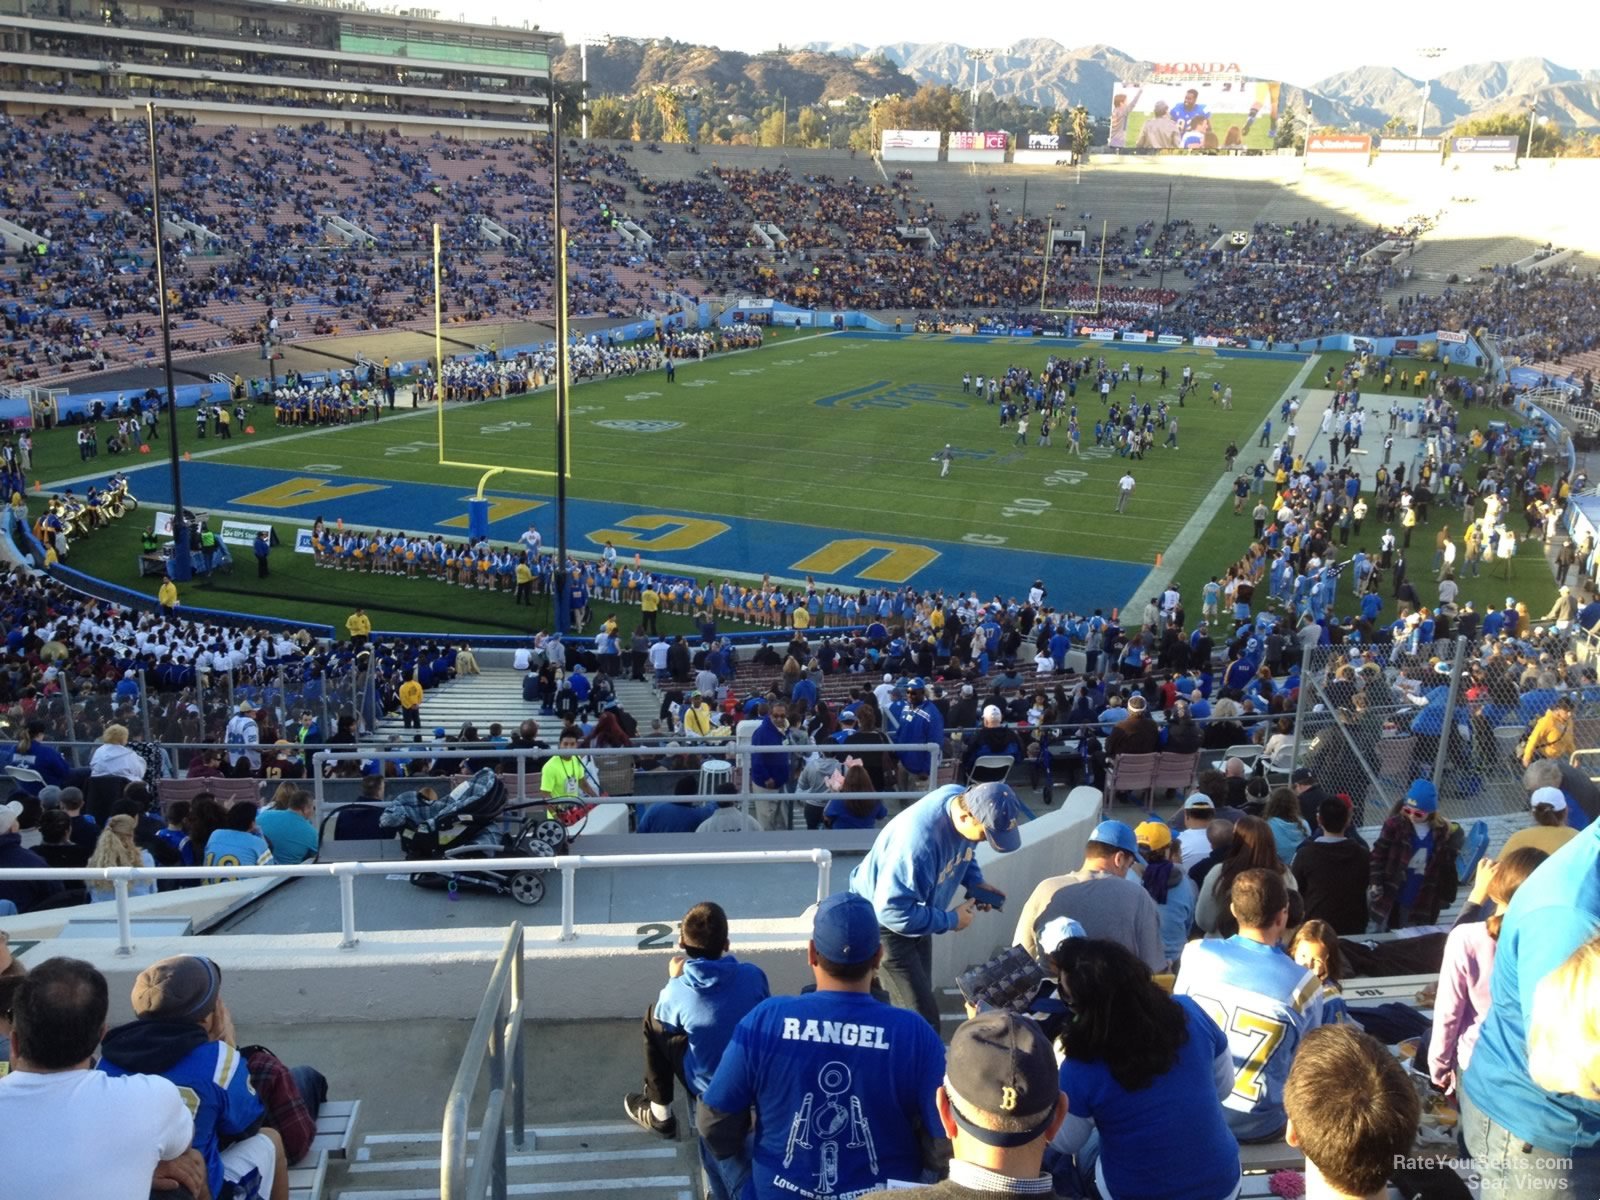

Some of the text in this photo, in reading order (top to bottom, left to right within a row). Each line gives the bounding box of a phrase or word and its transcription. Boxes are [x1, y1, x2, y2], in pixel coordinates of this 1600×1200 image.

[986, 137, 1004, 149] ICE
[1438, 331, 1465, 342] HONDA
[782, 1016, 890, 1050] RANGEL
[999, 1086, 1018, 1111] B
[772, 1174, 799, 1192] LOW
